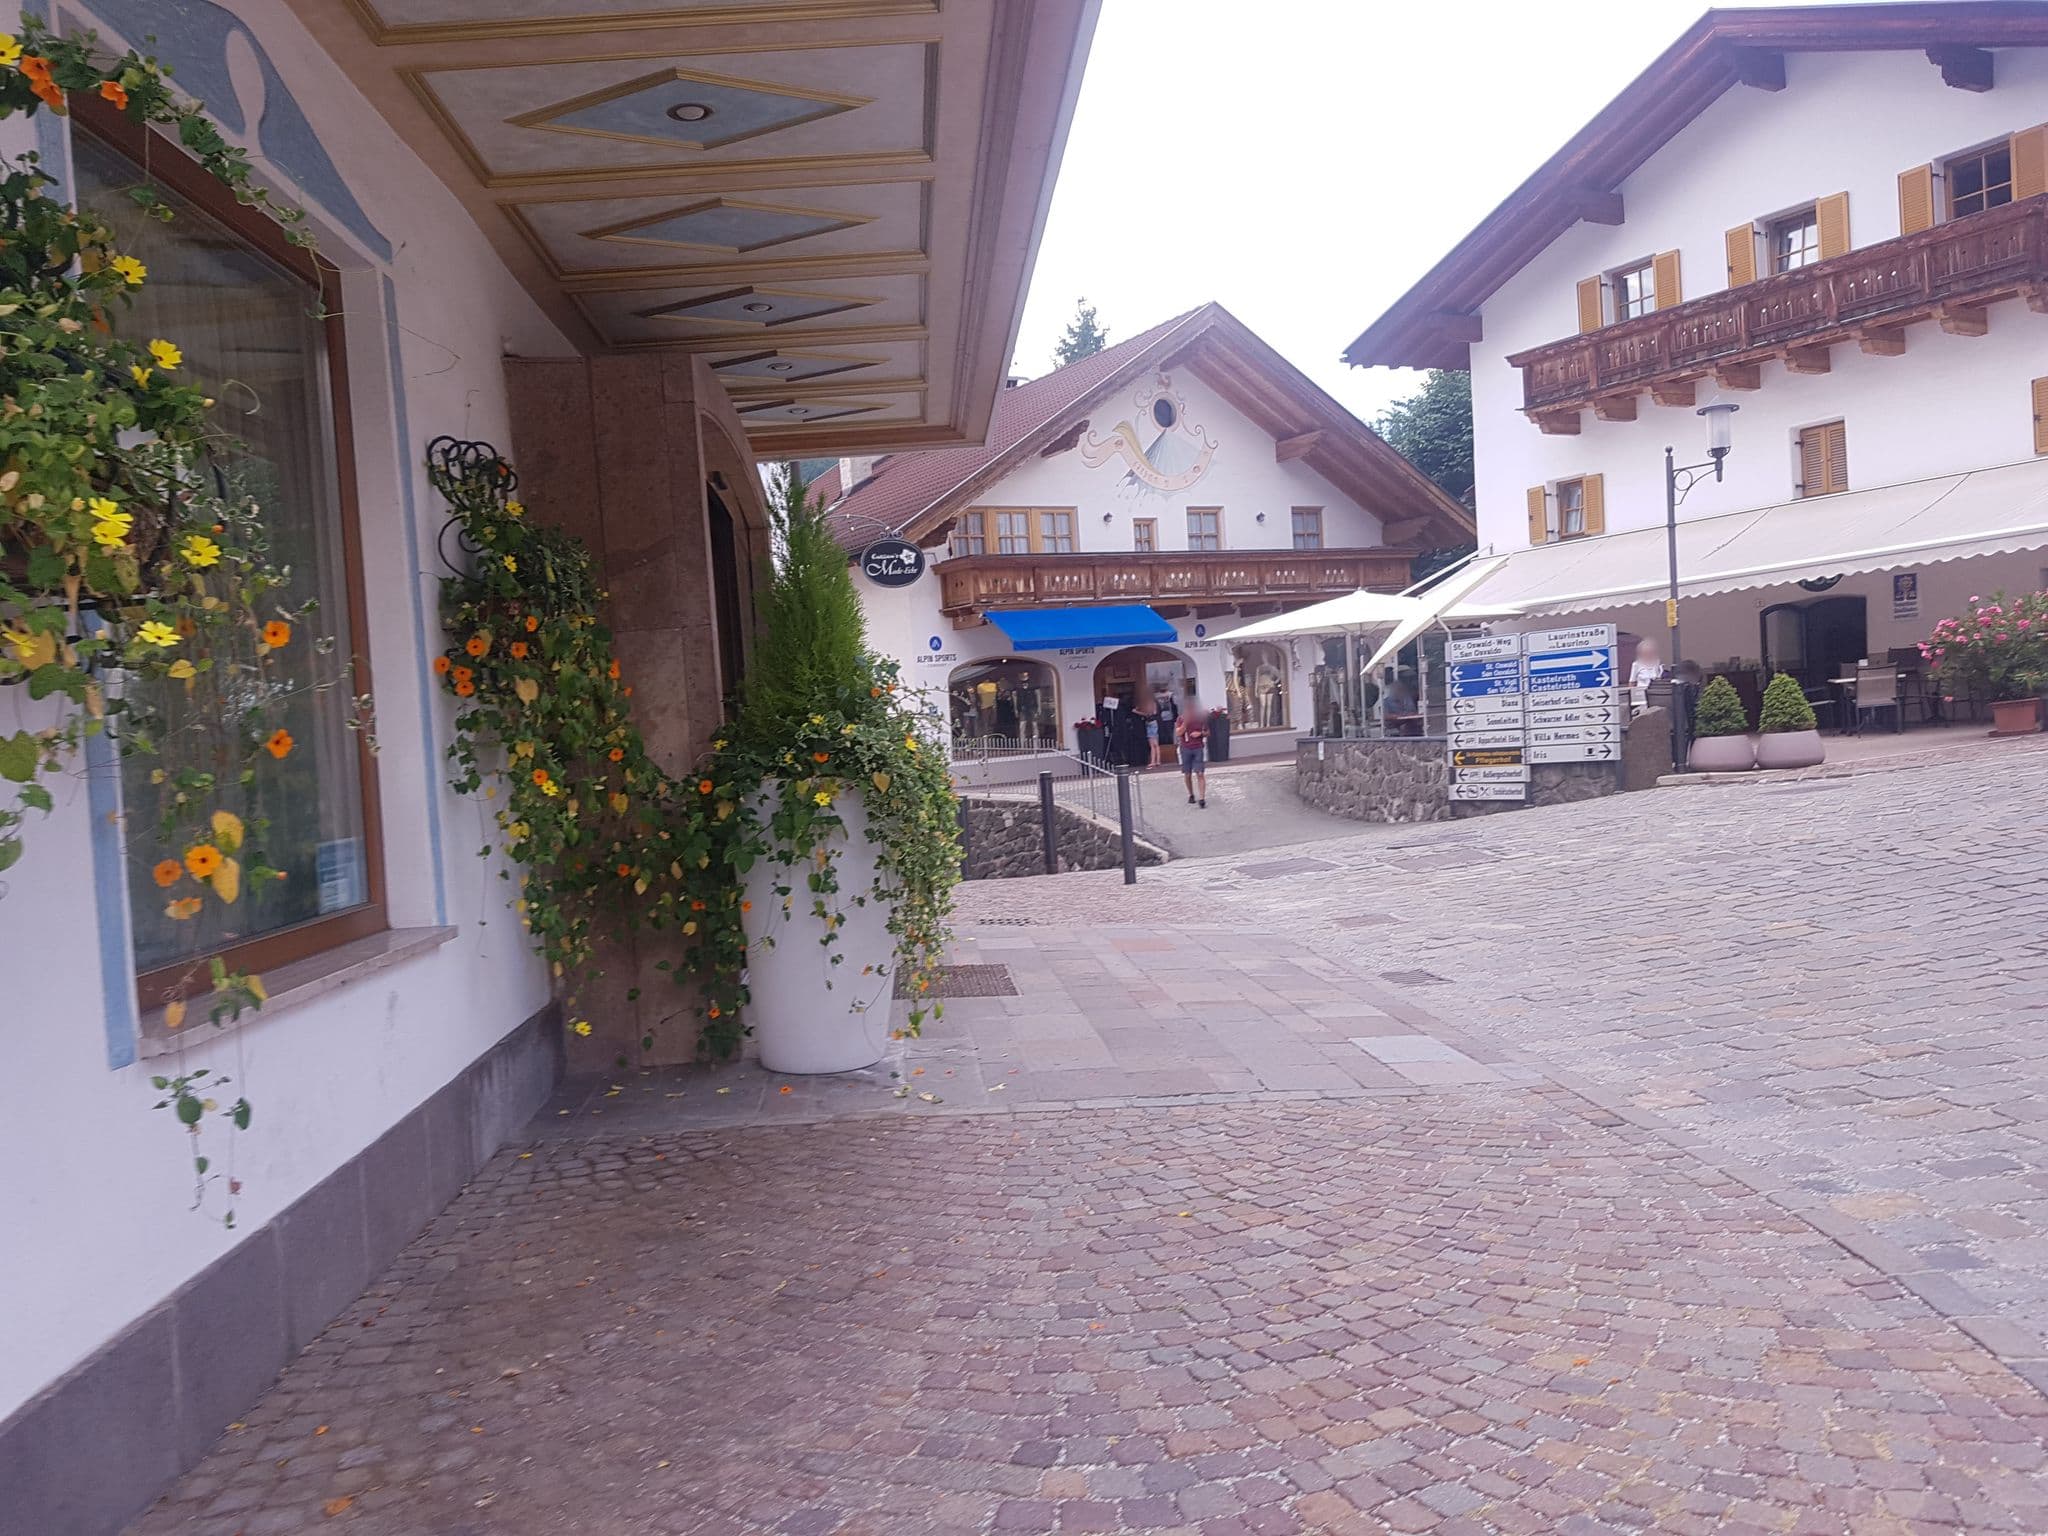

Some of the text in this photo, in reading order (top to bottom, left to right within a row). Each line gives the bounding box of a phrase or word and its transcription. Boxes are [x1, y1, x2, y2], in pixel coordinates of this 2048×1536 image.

[1548, 628, 1605, 641] Laurinstraße
[1556, 639, 1590, 648] Laurino
[917, 653, 958, 663] ALPIN SPORTS
[1531, 673, 1577, 684] Kastelruth
[1531, 682, 1581, 692] Castelrotto
[1534, 732, 1551, 741] Villa
[1533, 750, 1547, 759] Iris
